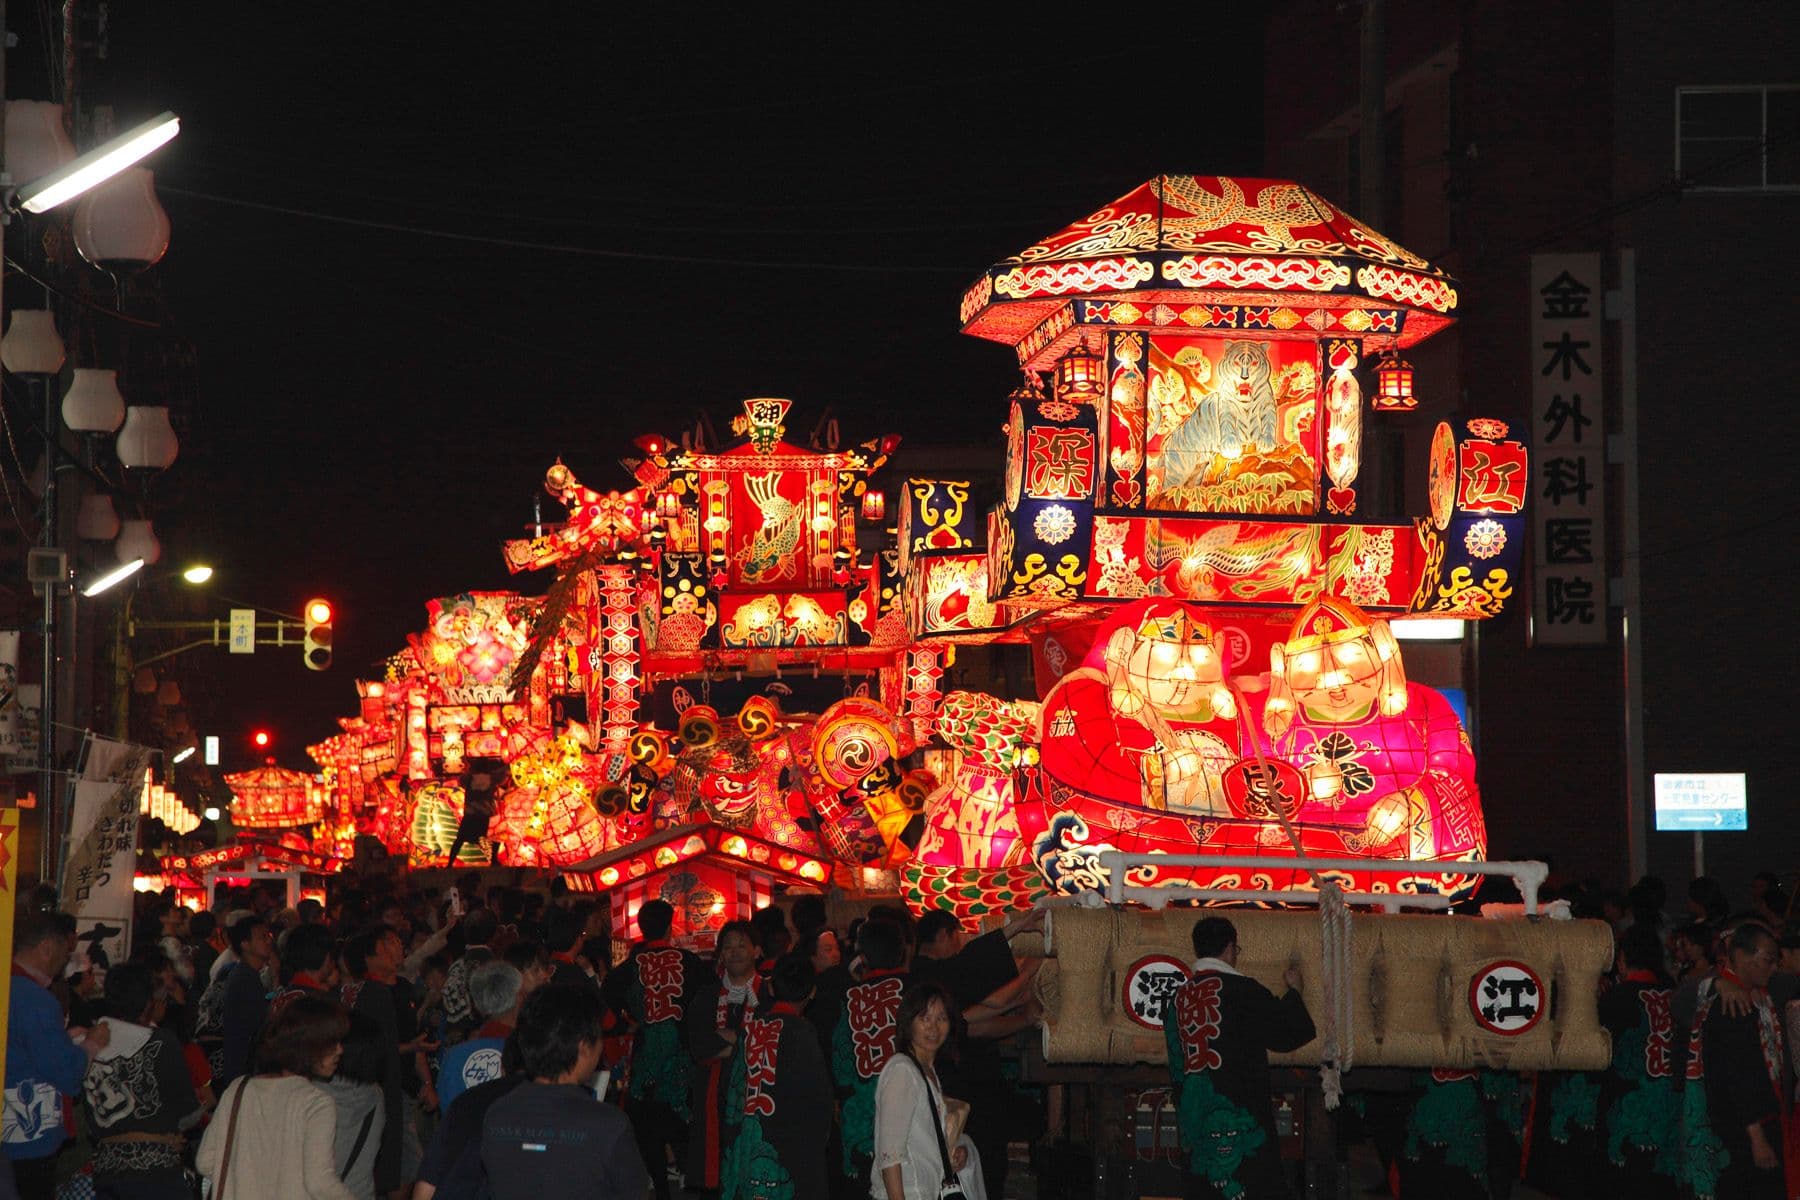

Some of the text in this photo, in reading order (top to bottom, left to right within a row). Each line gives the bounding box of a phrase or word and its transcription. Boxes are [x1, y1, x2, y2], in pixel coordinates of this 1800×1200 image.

[1031, 433, 1091, 494] 深
[1540, 270, 1594, 624] 金木外科医院
[1463, 451, 1521, 504] 江
[1482, 975, 1537, 1022] 江
